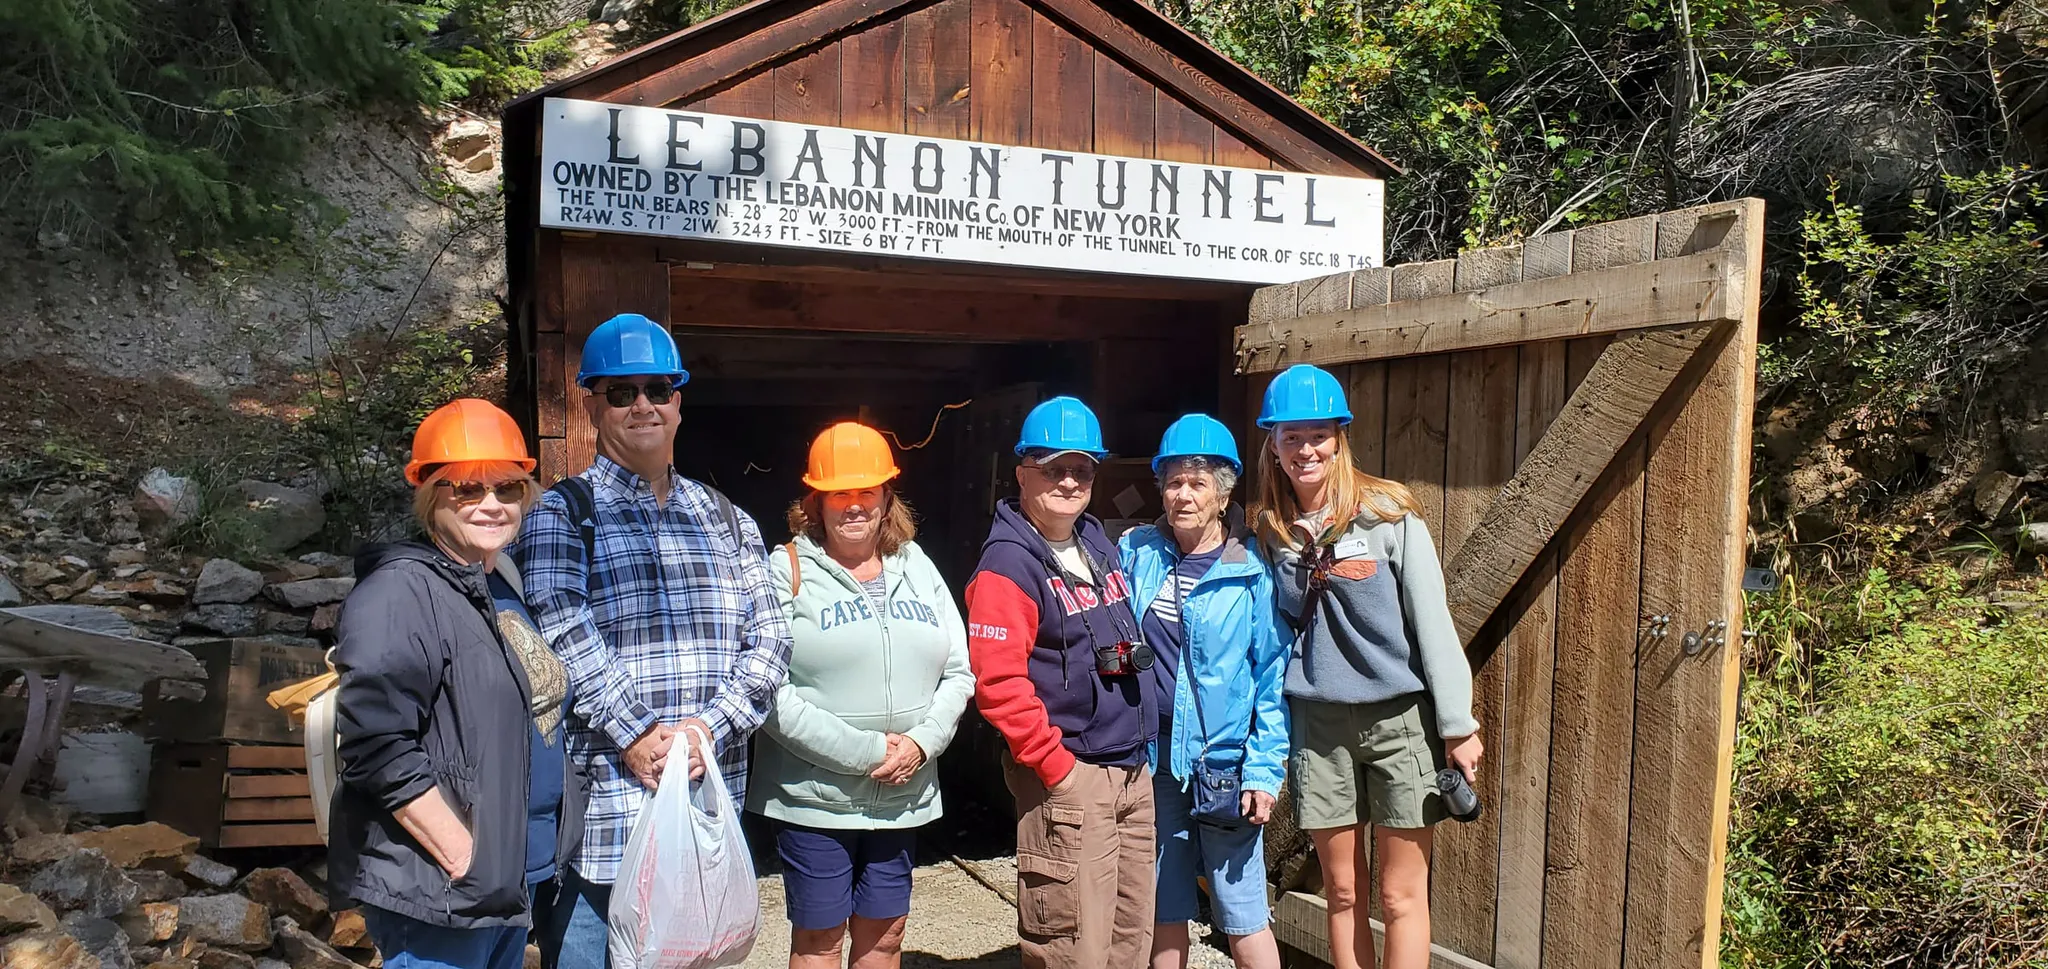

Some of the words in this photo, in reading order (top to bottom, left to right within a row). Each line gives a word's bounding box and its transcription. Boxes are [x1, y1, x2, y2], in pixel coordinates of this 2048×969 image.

[553, 161, 652, 192] OWNED
[664, 171, 698, 196] BY
[708, 175, 757, 202] THE
[766, 180, 883, 213] LEBANON
[893, 192, 981, 223] MINING
[1013, 204, 1044, 228] OF
[1053, 208, 1106, 232] NEW
[1115, 213, 1181, 239] YORK
[606, 108, 1002, 200] LEBANON
[1042, 152, 1336, 228] TUNNEL
[557, 188, 595, 206] THE
[604, 192, 650, 211] TUN.
[653, 196, 709, 215] BEARS
[809, 210, 828, 226] W.
[839, 213, 876, 230] 3000
[966, 225, 993, 241] THE
[999, 227, 1052, 246] MOUTH
[1058, 233, 1075, 247] OF
[1083, 235, 1112, 250] THE
[1118, 237, 1176, 255] TUNNEL
[1183, 242, 1201, 257] TO
[1207, 244, 1236, 260] THE
[732, 221, 772, 239] 3243
[780, 226, 801, 241] FT.
[818, 229, 851, 246] SIZE
[863, 233, 873, 247] 6
[880, 234, 898, 250] BY
[905, 236, 914, 251] 7
[922, 238, 944, 254] FT.
[820, 595, 873, 631] CAPE
[889, 599, 928, 623] COD
